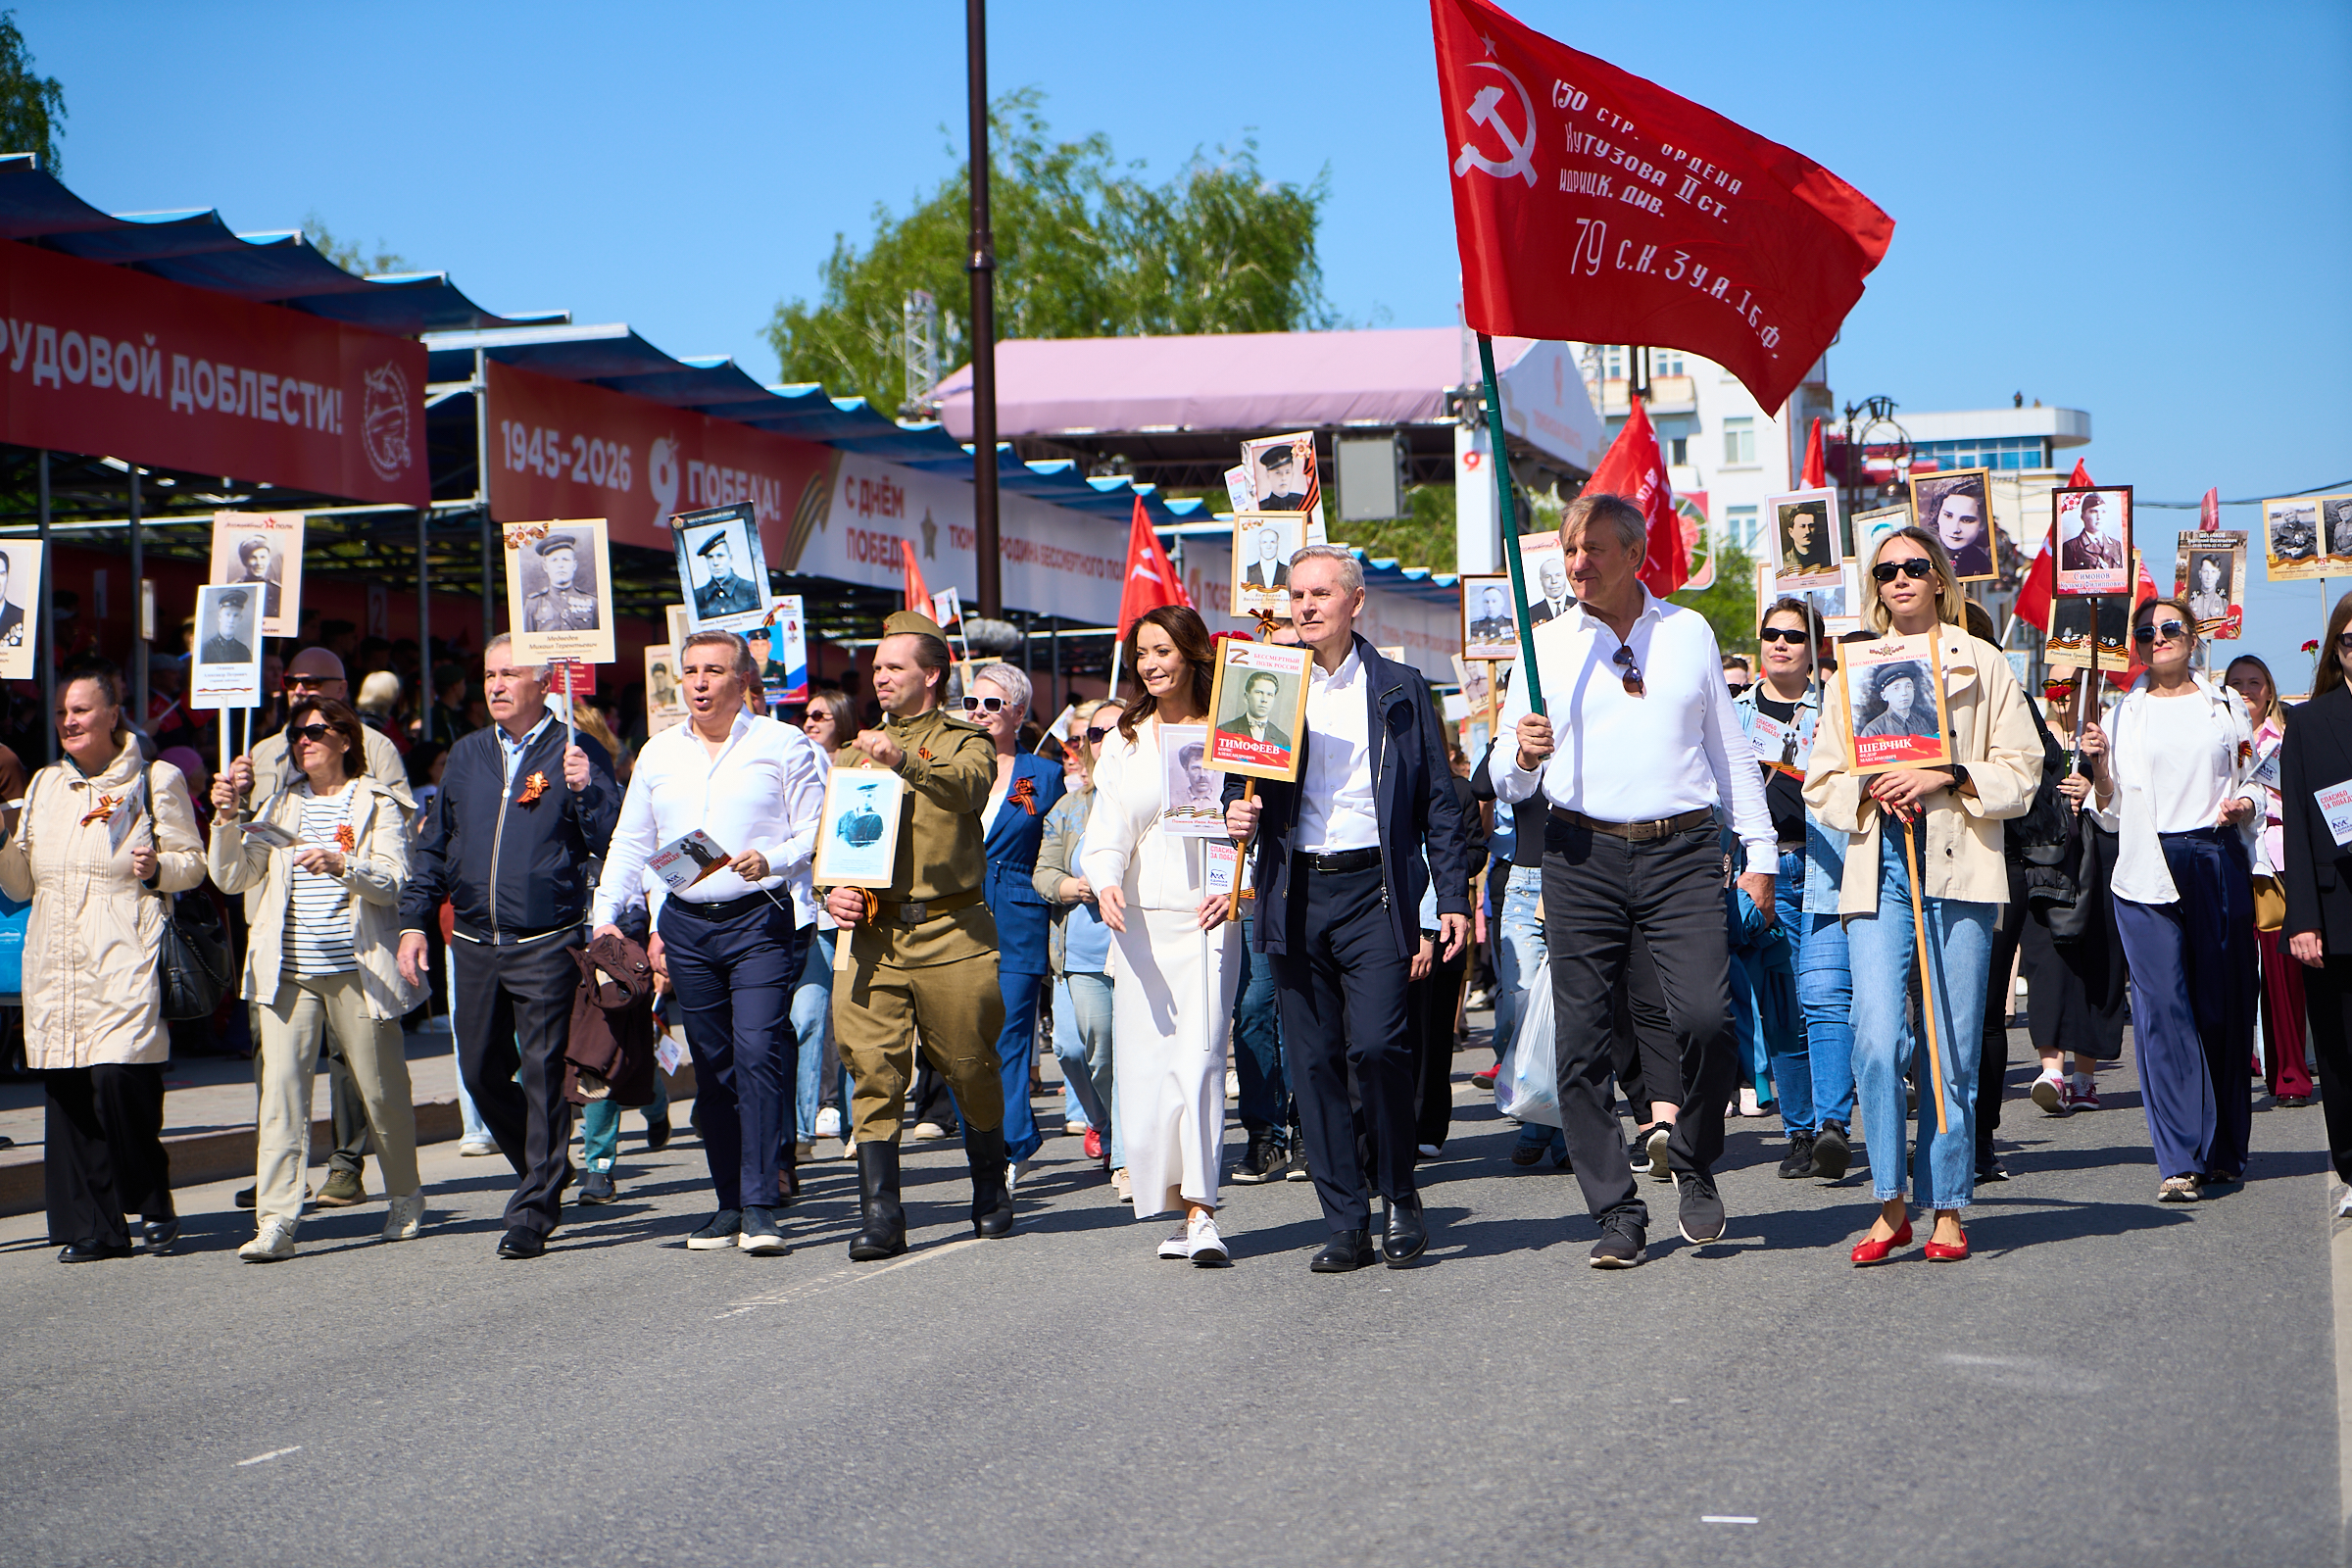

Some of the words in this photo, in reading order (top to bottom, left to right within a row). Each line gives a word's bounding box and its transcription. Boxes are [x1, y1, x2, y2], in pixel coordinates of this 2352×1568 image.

[1570, 218, 1607, 276] 79
[0, 316, 162, 400] УДОВОЙ
[170, 353, 343, 435] ДОБЛЕСТИ!
[501, 419, 632, 493] 1945-2026
[688, 459, 781, 521] ПОБЕДА!
[845, 475, 856, 510] С
[858, 474, 905, 520] ДНЁМ
[1253, 653, 1300, 664] БЕССМЕРТНЫЙ
[1255, 660, 1273, 668] ПОЛК
[1274, 662, 1299, 671] РОССИИ
[1849, 657, 1889, 667] БЕССМЕРТНЫЙ
[1755, 717, 1778, 731] СПАСИБО
[1218, 738, 1280, 755] ТИМОФЕЕВ
[1858, 738, 1913, 754] ШЕВЧИК
[1216, 751, 1256, 760] АЛЕКСАНДРОВИЧ
[1859, 754, 1897, 762] МАКСИМОВИЧ
[2320, 789, 2348, 805] СПАСИБО
[2323, 803, 2331, 811] ЗА
[2331, 796, 2352, 808] ПОБЕД
[650, 851, 672, 866] СПАСИБО
[1219, 853, 1238, 862] ПОБЕД
